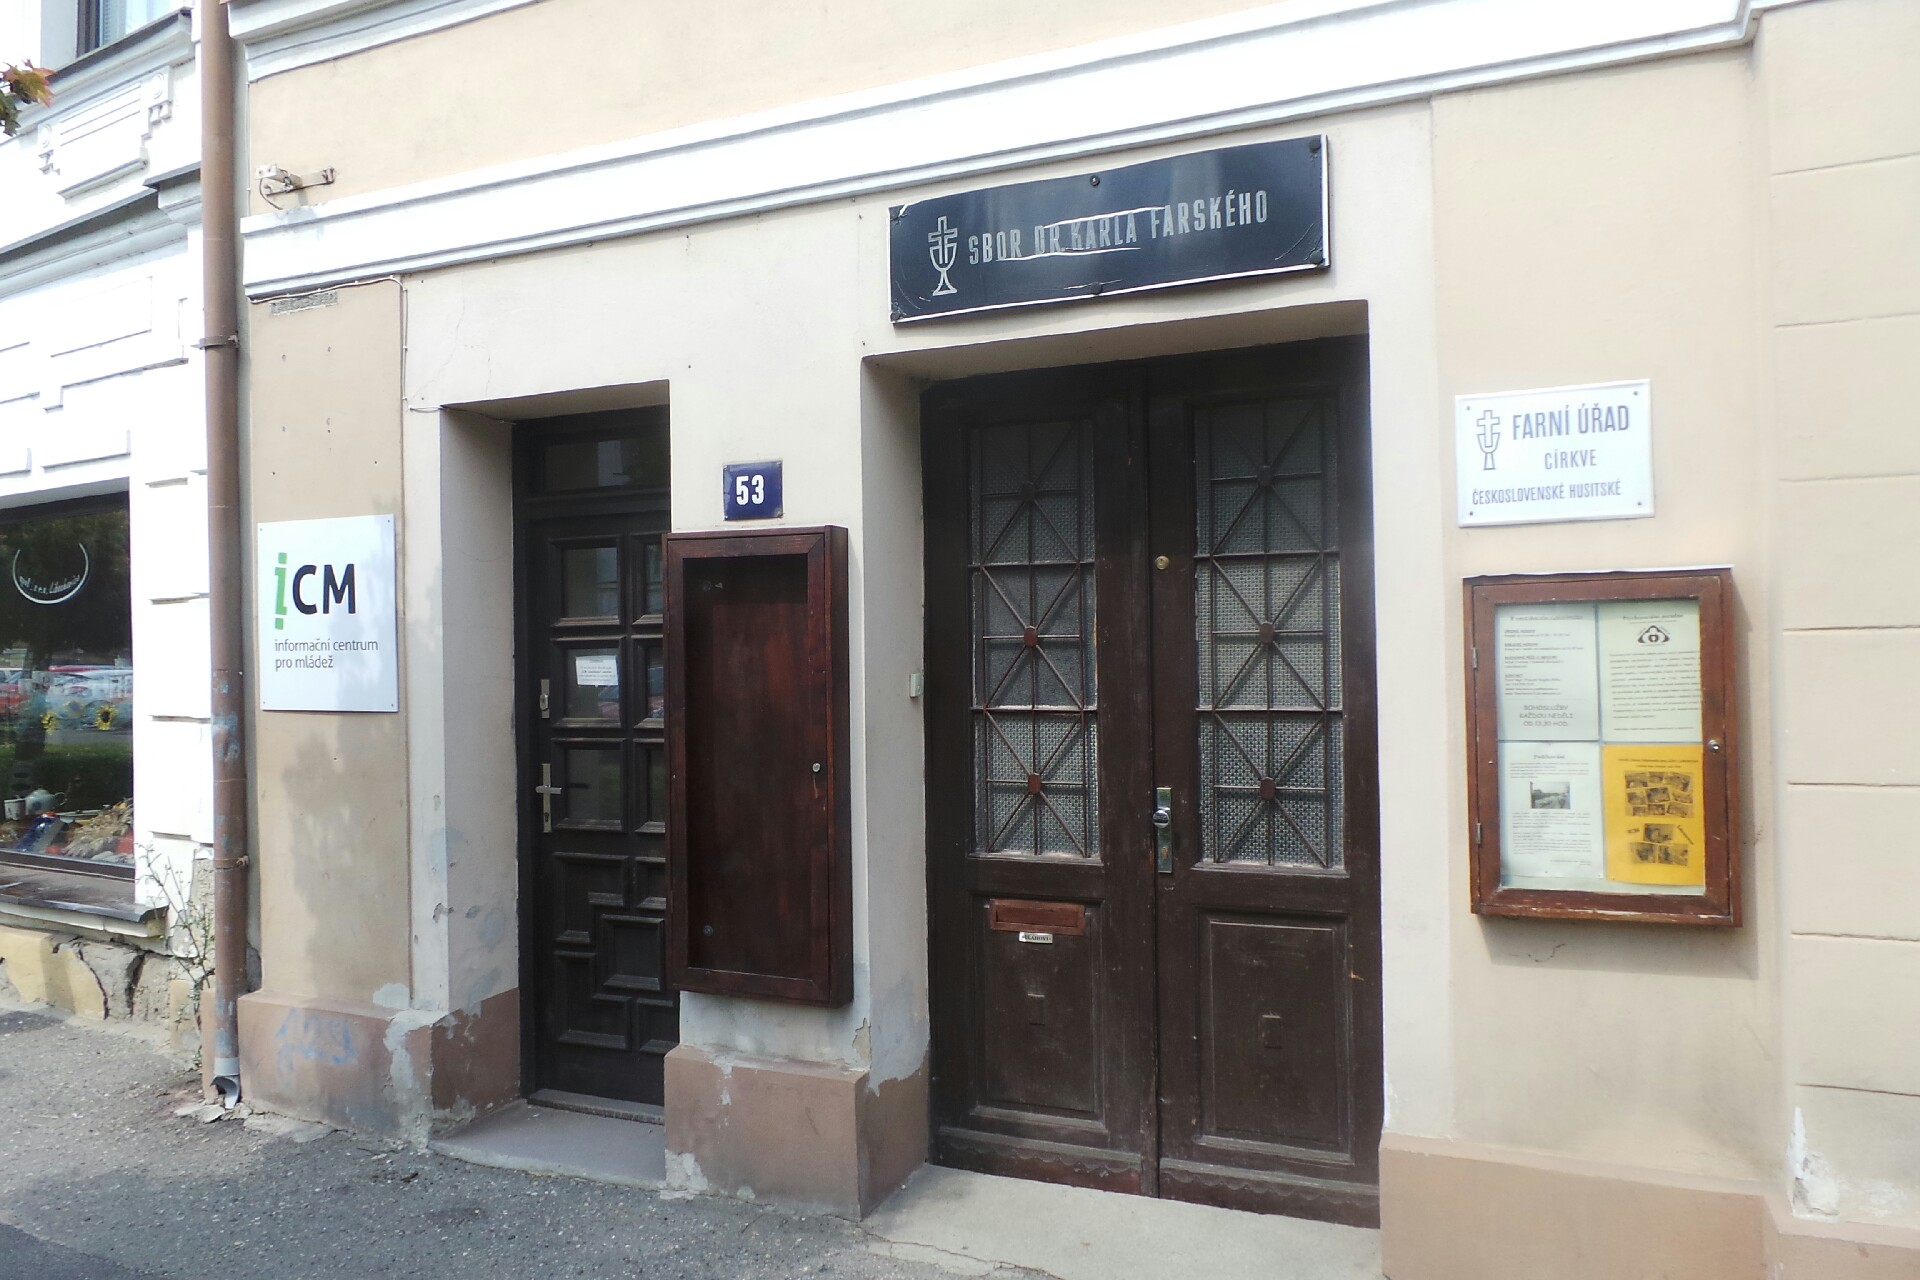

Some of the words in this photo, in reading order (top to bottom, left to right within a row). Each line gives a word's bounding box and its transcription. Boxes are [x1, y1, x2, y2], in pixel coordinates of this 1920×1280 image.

[968, 228, 1021, 266] SBOR
[1070, 212, 1138, 249] KARLA
[1149, 189, 1268, 239] FARSKÉHO
[1512, 404, 1570, 440] FARNÍ
[1577, 402, 1630, 434] ÚŘAD
[1544, 448, 1597, 470] CÍRKVE
[736, 474, 765, 506] 53
[1472, 481, 1565, 505] ČESKOSLOVENSKÉ
[1569, 478, 1621, 499] HUSITSKÉ
[274, 551, 356, 631] iCM
[274, 638, 331, 652] informační
[332, 640, 379, 652] centrum
[275, 658, 293, 672] pro
[295, 654, 334, 669] mládež
